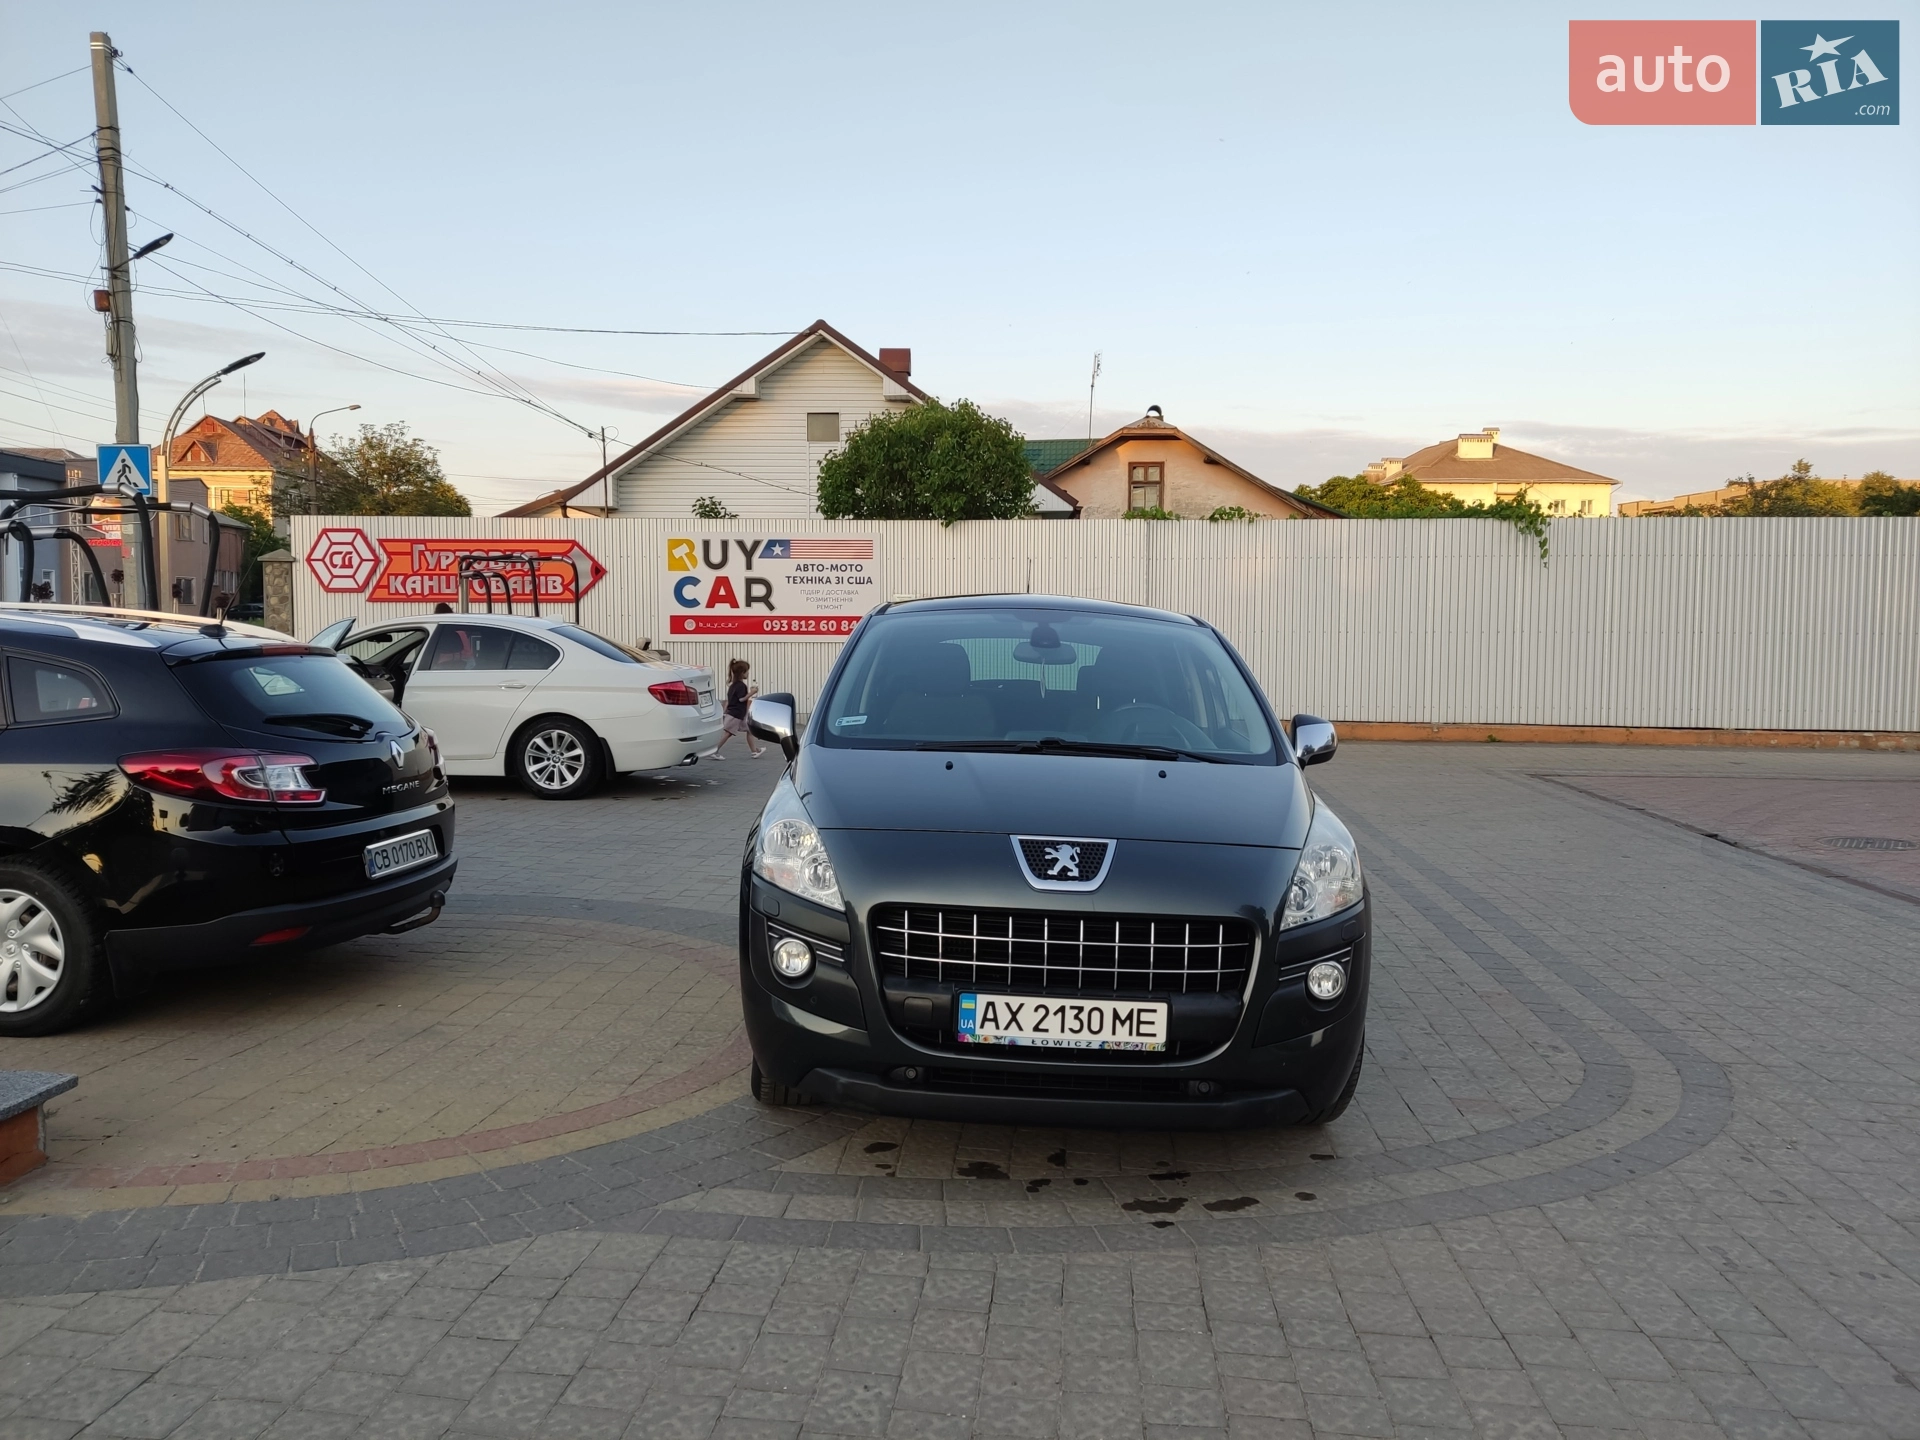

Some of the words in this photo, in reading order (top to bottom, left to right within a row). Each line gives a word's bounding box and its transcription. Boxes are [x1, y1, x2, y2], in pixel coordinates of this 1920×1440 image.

[667, 538, 763, 572] BUY
[795, 563, 864, 573] АВТО-МОТО
[389, 574, 564, 597] КАНЦОВАРІВ
[785, 575, 833, 585] ТЕХНІКА
[846, 576, 873, 585] США
[673, 575, 776, 612] CAR
[763, 619, 789, 632] 093
[791, 619, 816, 632] 812
[819, 620, 837, 632] 60
[840, 620, 857, 632] 84
[382, 780, 420, 795] MEGANE
[374, 849, 391, 870] CB
[392, 841, 416, 864] 0170
[960, 1019, 975, 1030] UA
[979, 1001, 1025, 1032] AX
[1032, 1003, 1104, 1036] 2130
[1111, 1007, 1158, 1038] ME
